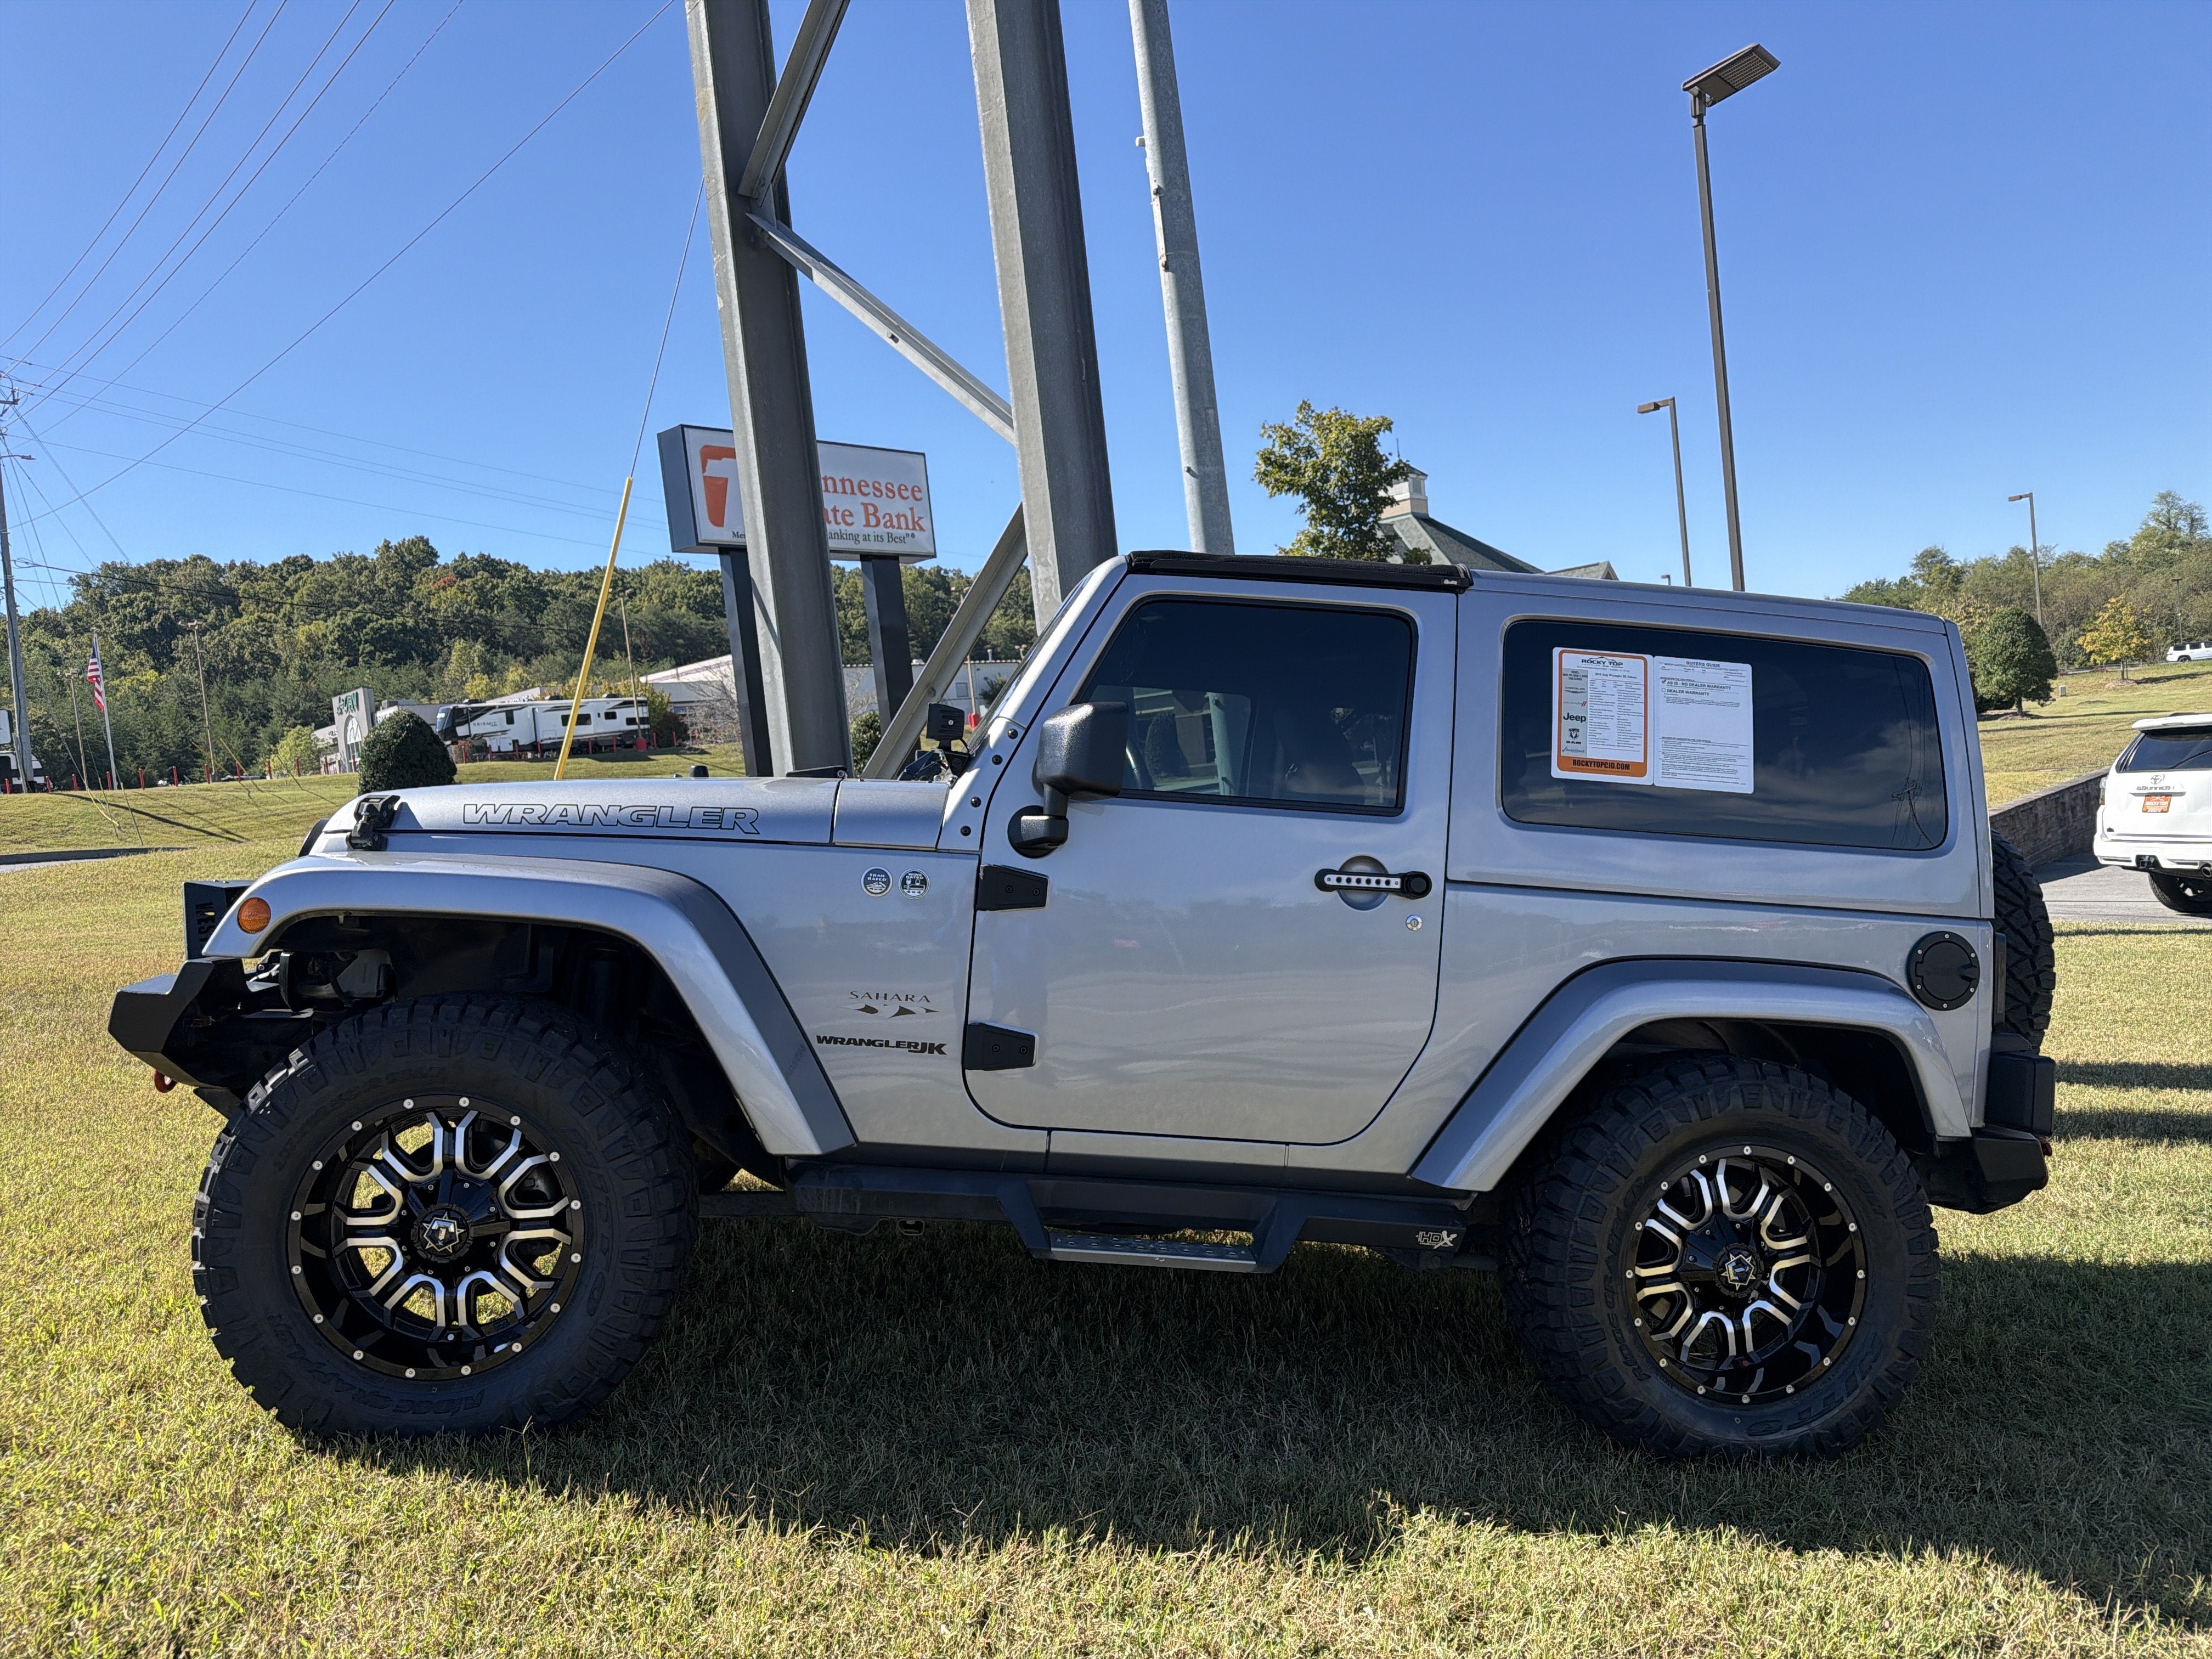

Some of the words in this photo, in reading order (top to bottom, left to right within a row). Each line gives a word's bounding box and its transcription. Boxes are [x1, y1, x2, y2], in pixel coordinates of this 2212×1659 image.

[822, 475, 923, 501] nnessee
[860, 502, 926, 532] Bank
[827, 529, 860, 545] anking
[862, 533, 871, 542] at
[873, 531, 884, 542] its
[1563, 712, 1587, 723] Jeep
[1572, 759, 1630, 770] ROCKYTOPCJD.COM
[462, 803, 761, 835] WRANGLER
[850, 990, 931, 1003] SAHARA
[1418, 1230, 1458, 1249] HDX
